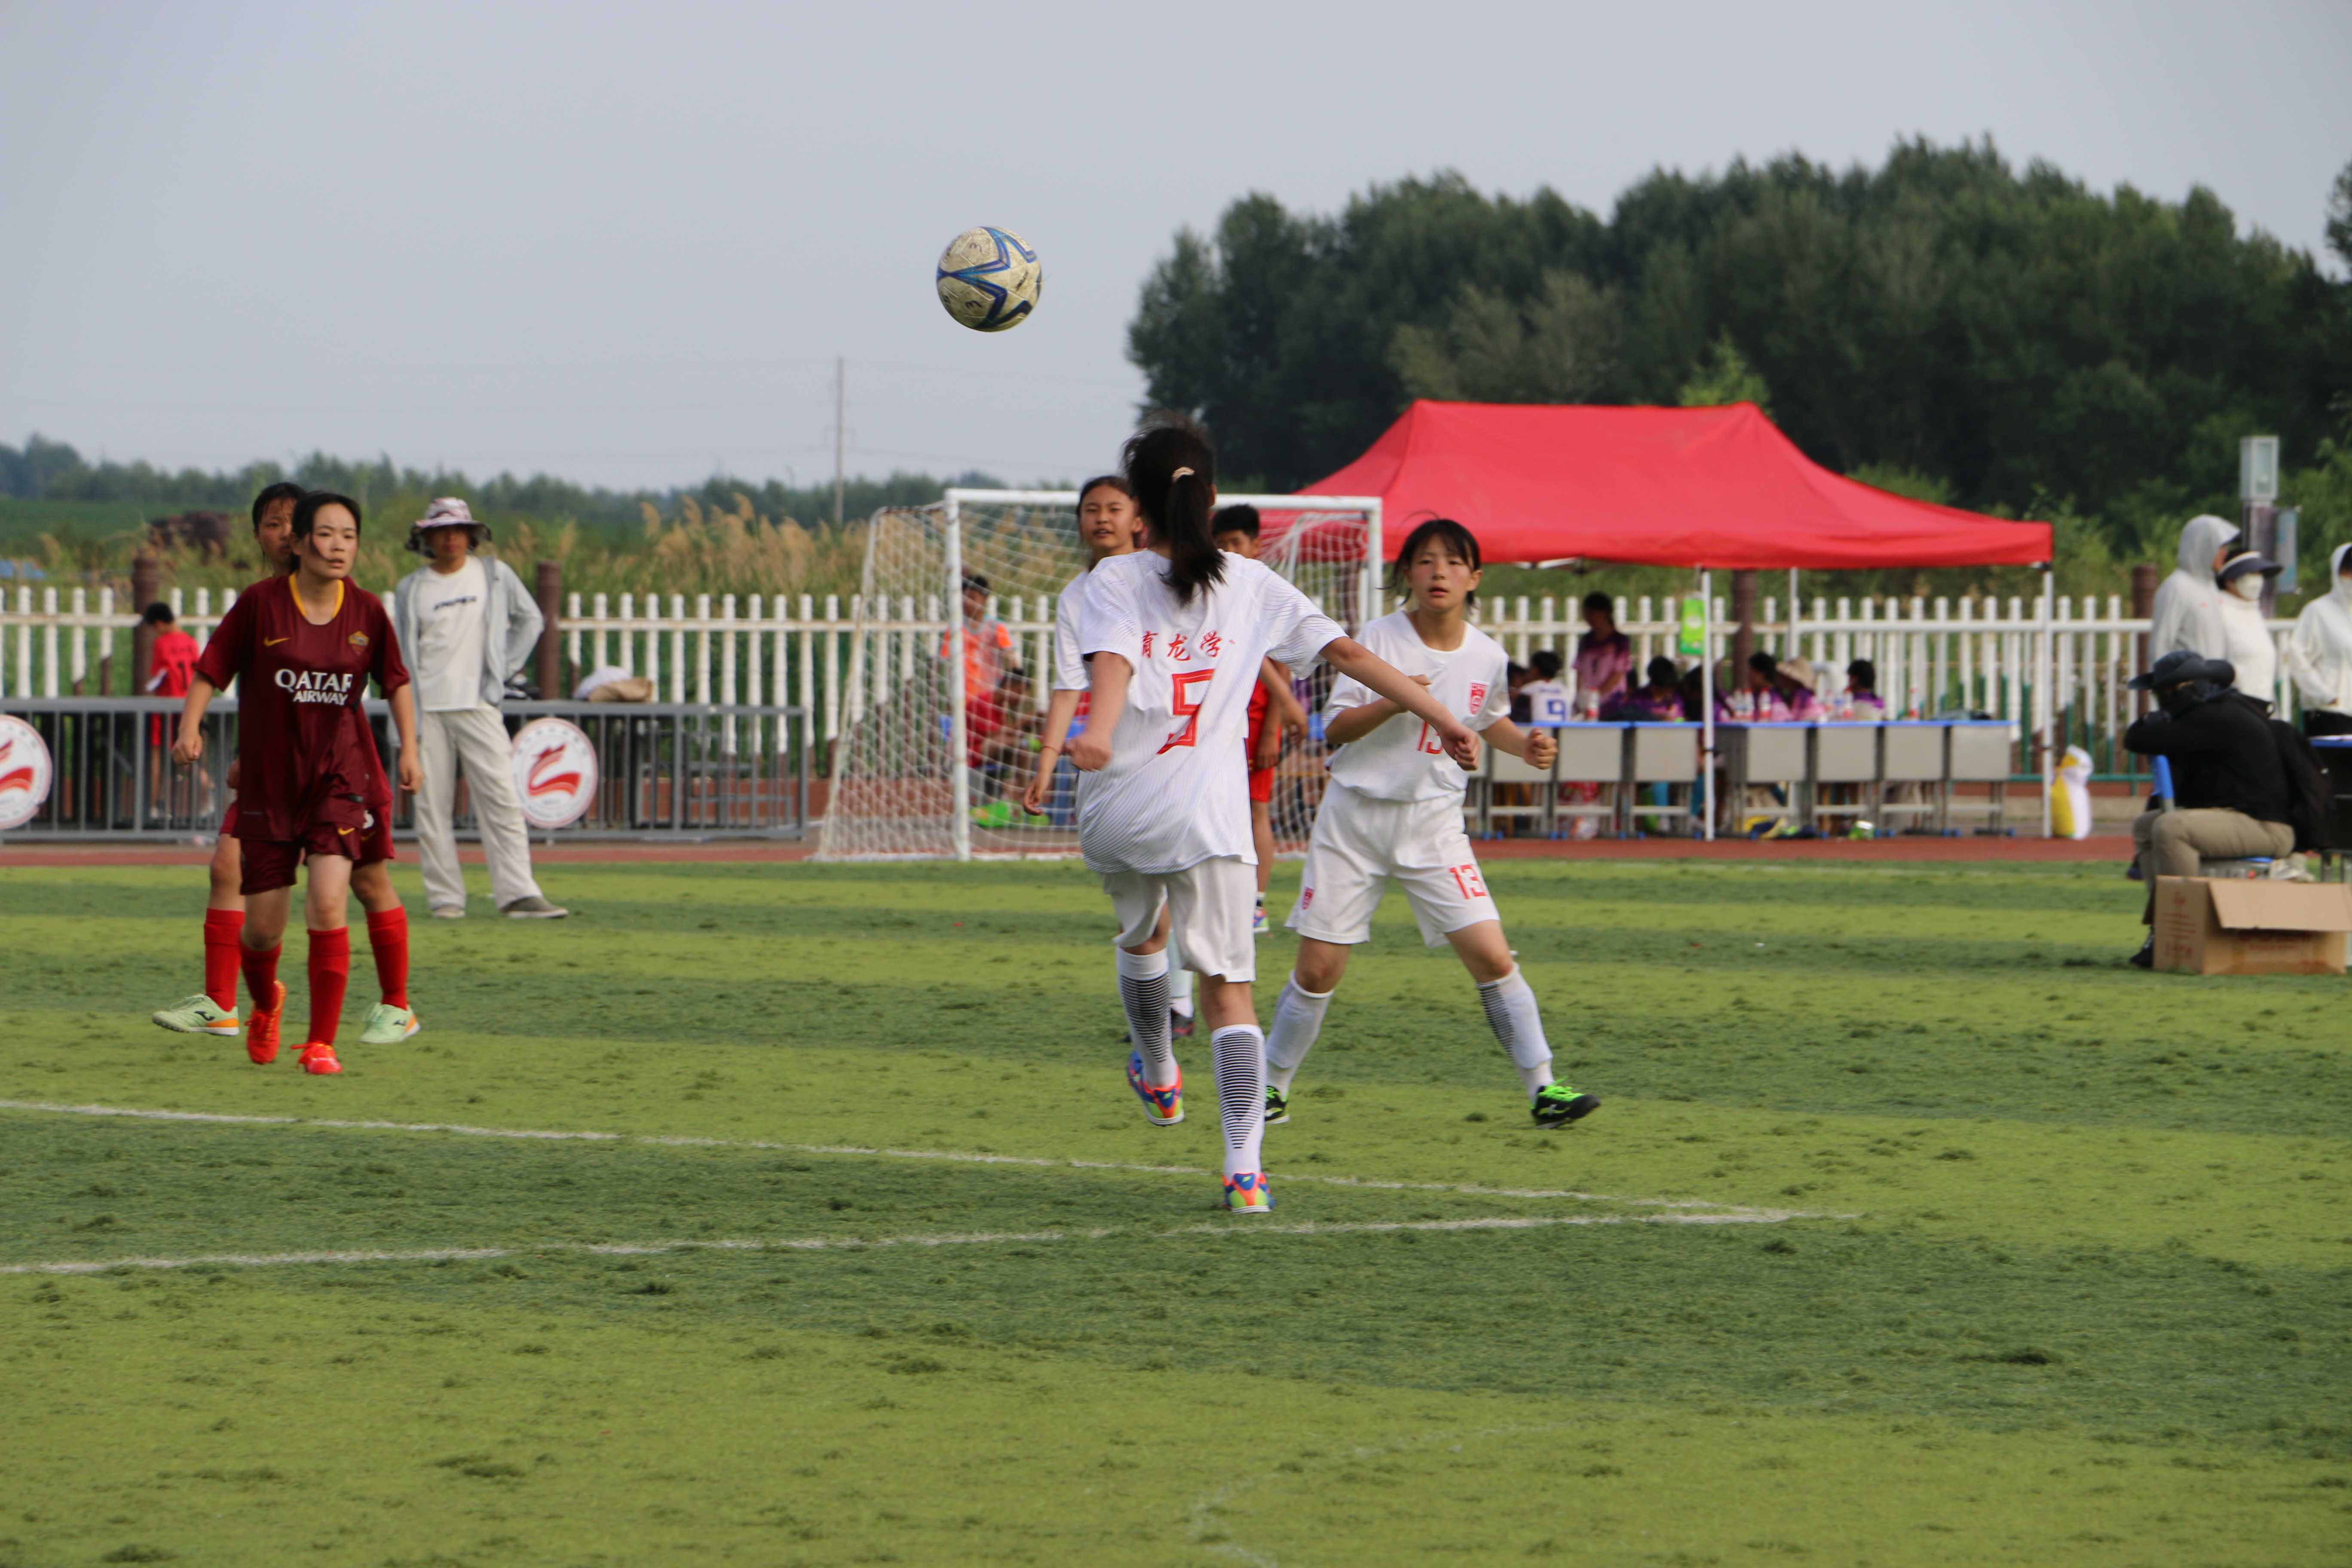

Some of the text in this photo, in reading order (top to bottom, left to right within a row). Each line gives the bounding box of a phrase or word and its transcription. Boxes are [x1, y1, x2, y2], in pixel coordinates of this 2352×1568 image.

[1141, 630, 1236, 661] 育龙学
[292, 690, 349, 706] AIRWAY
[1155, 668, 1216, 755] 5
[1546, 698, 1566, 722] 9
[1449, 864, 1488, 900] 13
